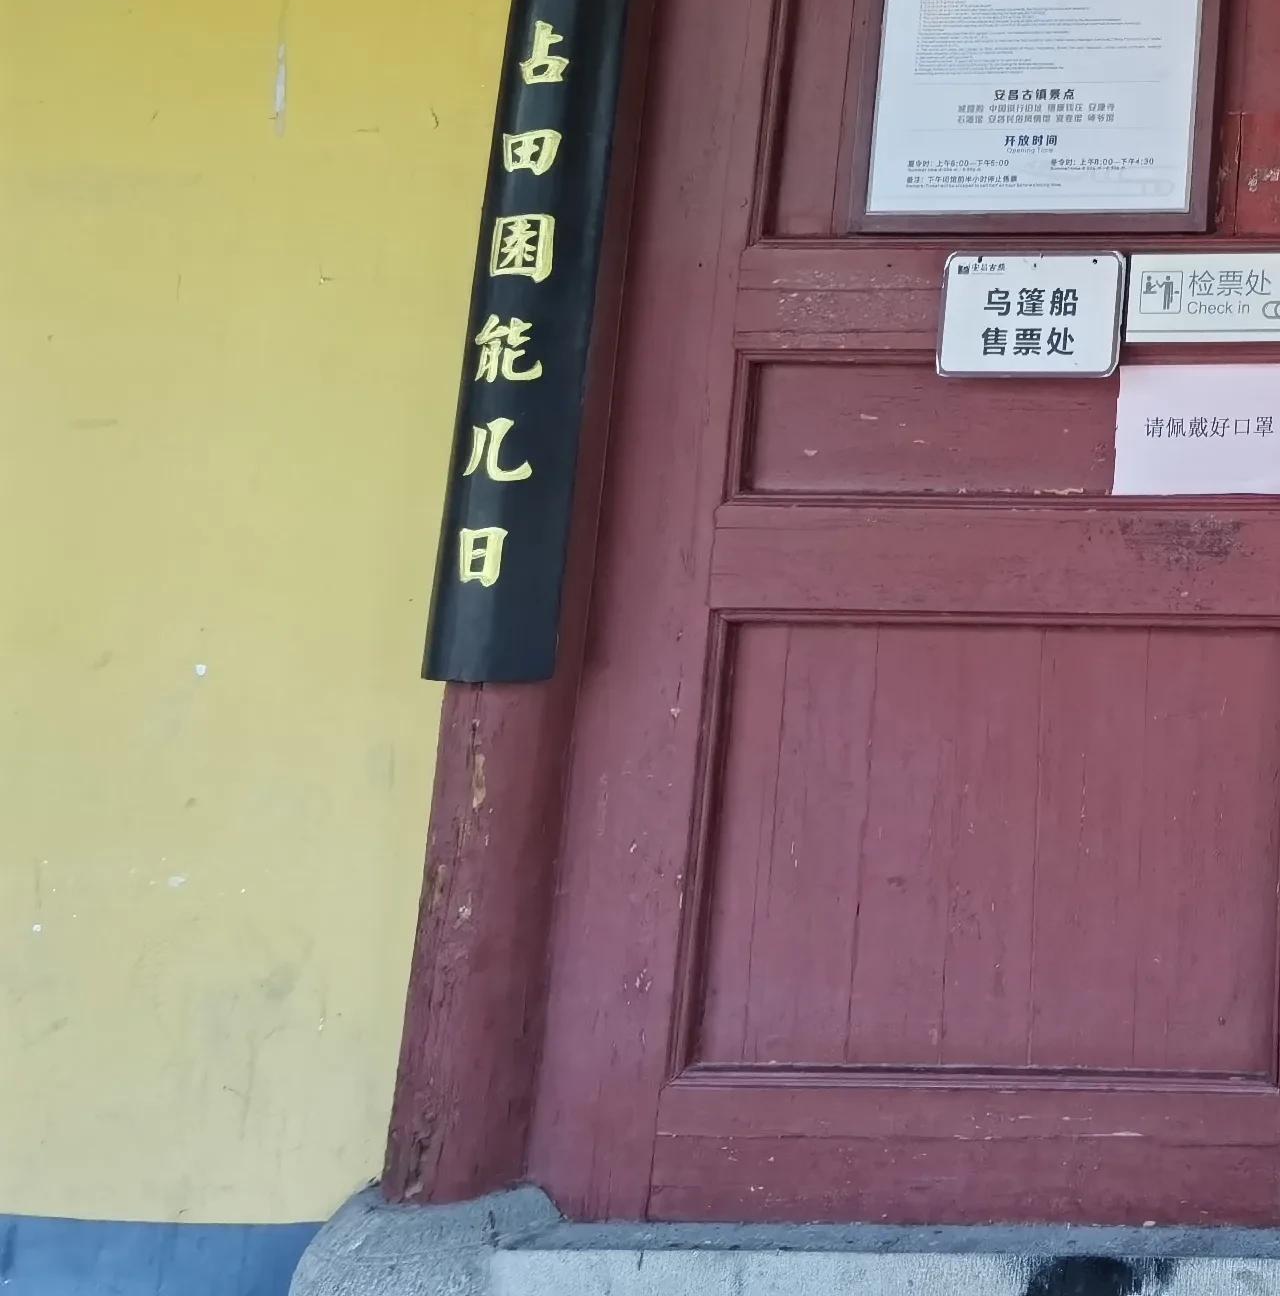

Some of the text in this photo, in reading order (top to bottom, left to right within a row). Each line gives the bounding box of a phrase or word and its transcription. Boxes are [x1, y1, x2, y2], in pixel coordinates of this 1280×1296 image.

[993, 88, 1075, 101] 安昌古镇景点
[1003, 134, 1058, 147] 开放时间
[1188, 269, 1272, 297] 检票处
[983, 287, 1079, 317] 乌篷船
[1187, 301, 1250, 315] Check in
[981, 327, 1075, 356] 售票处
[1144, 415, 1274, 438] 请佩戴好口罩
